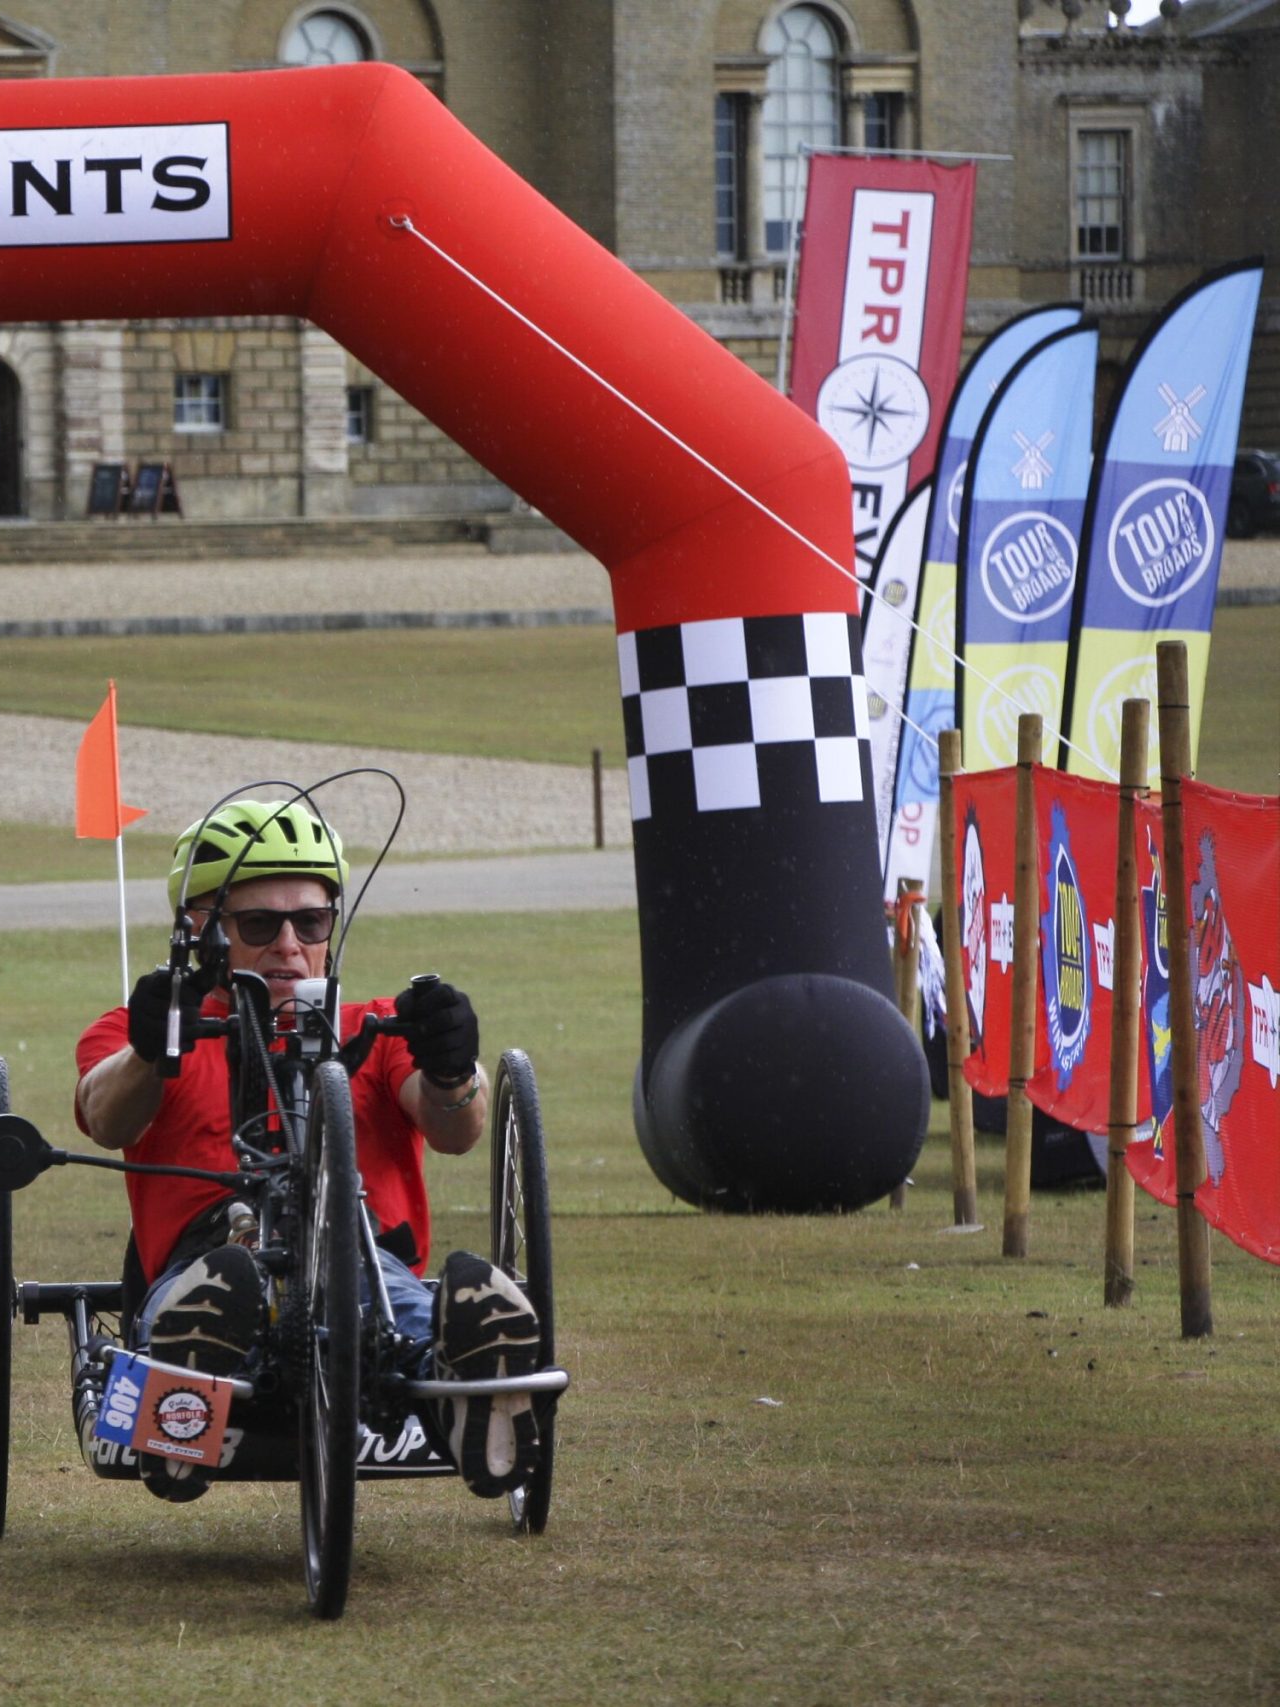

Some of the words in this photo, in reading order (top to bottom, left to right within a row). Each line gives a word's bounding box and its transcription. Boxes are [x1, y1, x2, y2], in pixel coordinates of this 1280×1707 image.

[861, 210, 911, 345] TPR
[989, 522, 1054, 590] TOUR
[1119, 491, 1192, 568] TOUR
[1012, 557, 1072, 612] BROADS
[1142, 533, 1204, 594] BROADS
[105, 1375, 141, 1431] 406
[166, 1410, 202, 1422] NORFOLK
